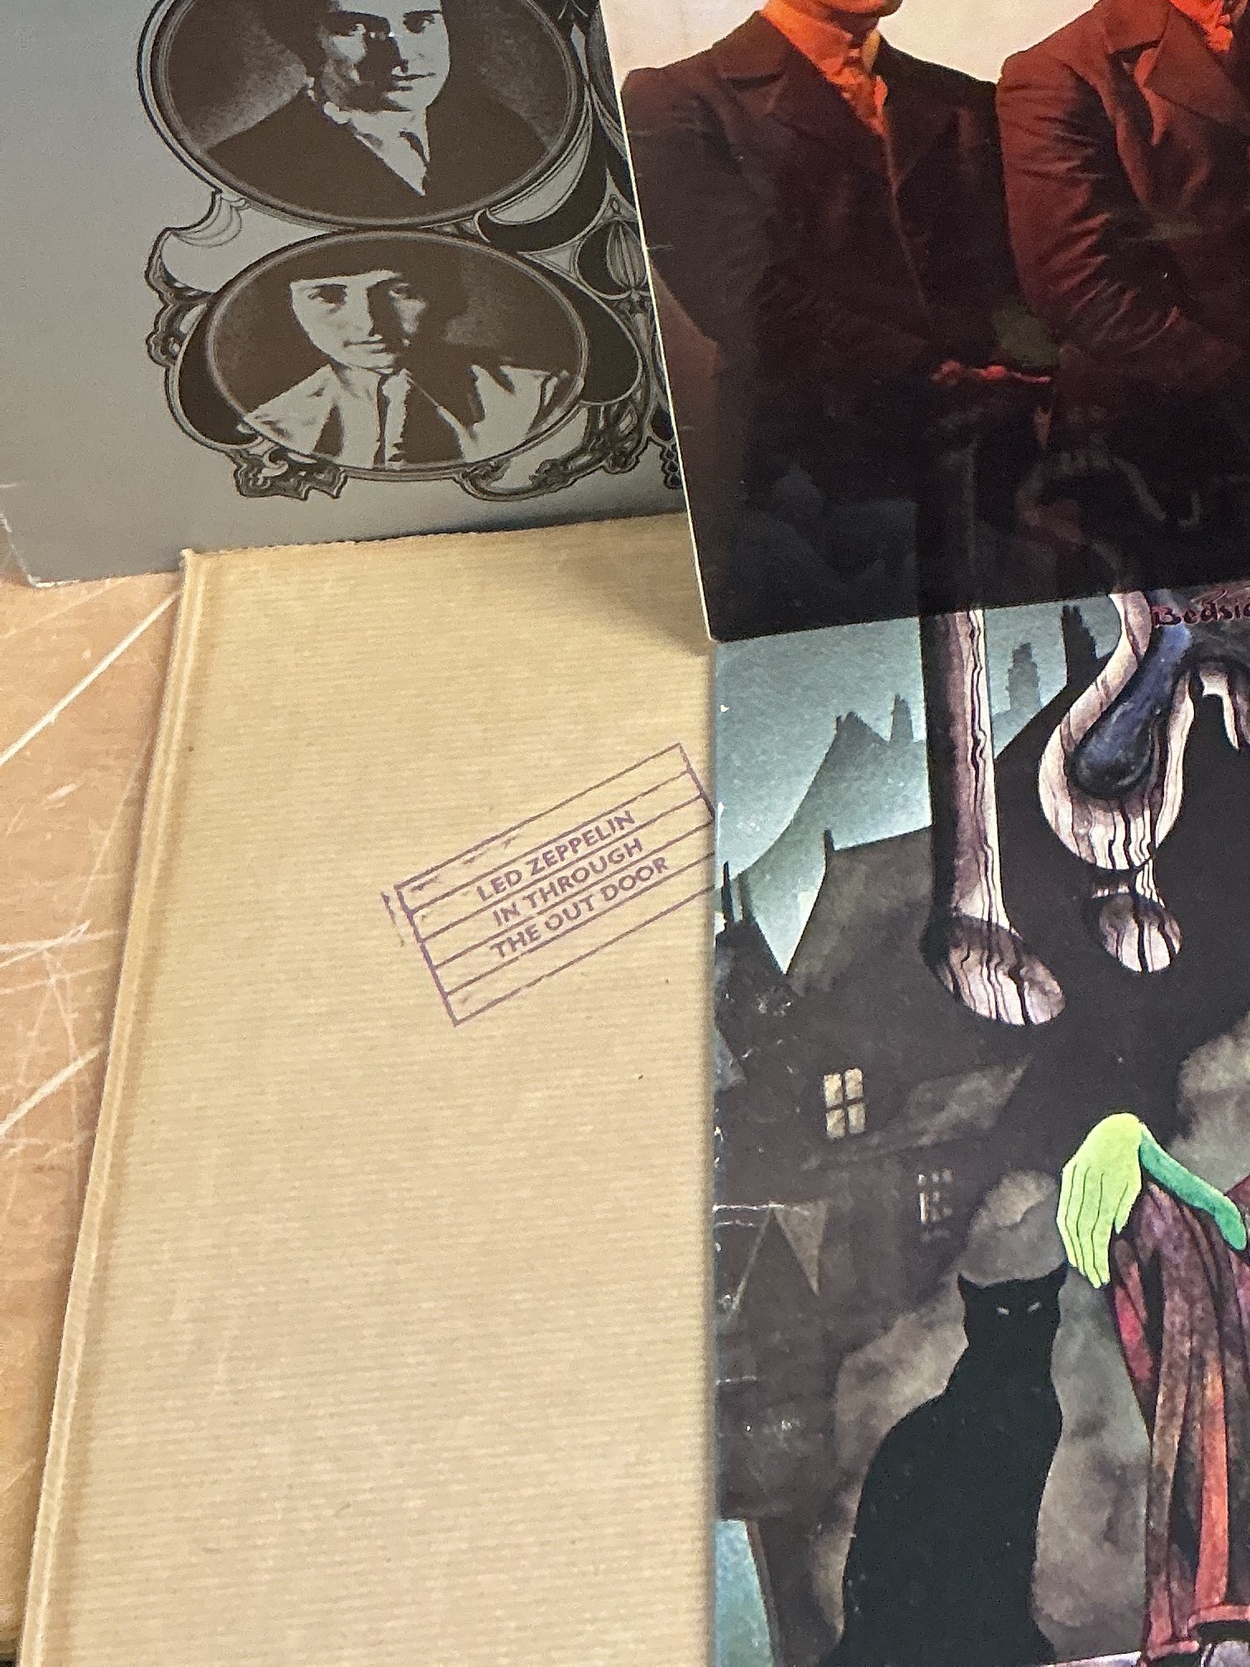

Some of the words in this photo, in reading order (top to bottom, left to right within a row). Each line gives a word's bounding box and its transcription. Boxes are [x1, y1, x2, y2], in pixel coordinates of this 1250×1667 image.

[475, 869, 524, 902] LED
[526, 809, 637, 877] ZEPPELIN
[491, 902, 519, 927] IN
[523, 836, 645, 909] THROUGH
[489, 927, 542, 960] THE
[543, 897, 597, 932] OUT
[599, 855, 671, 905] DOOR
